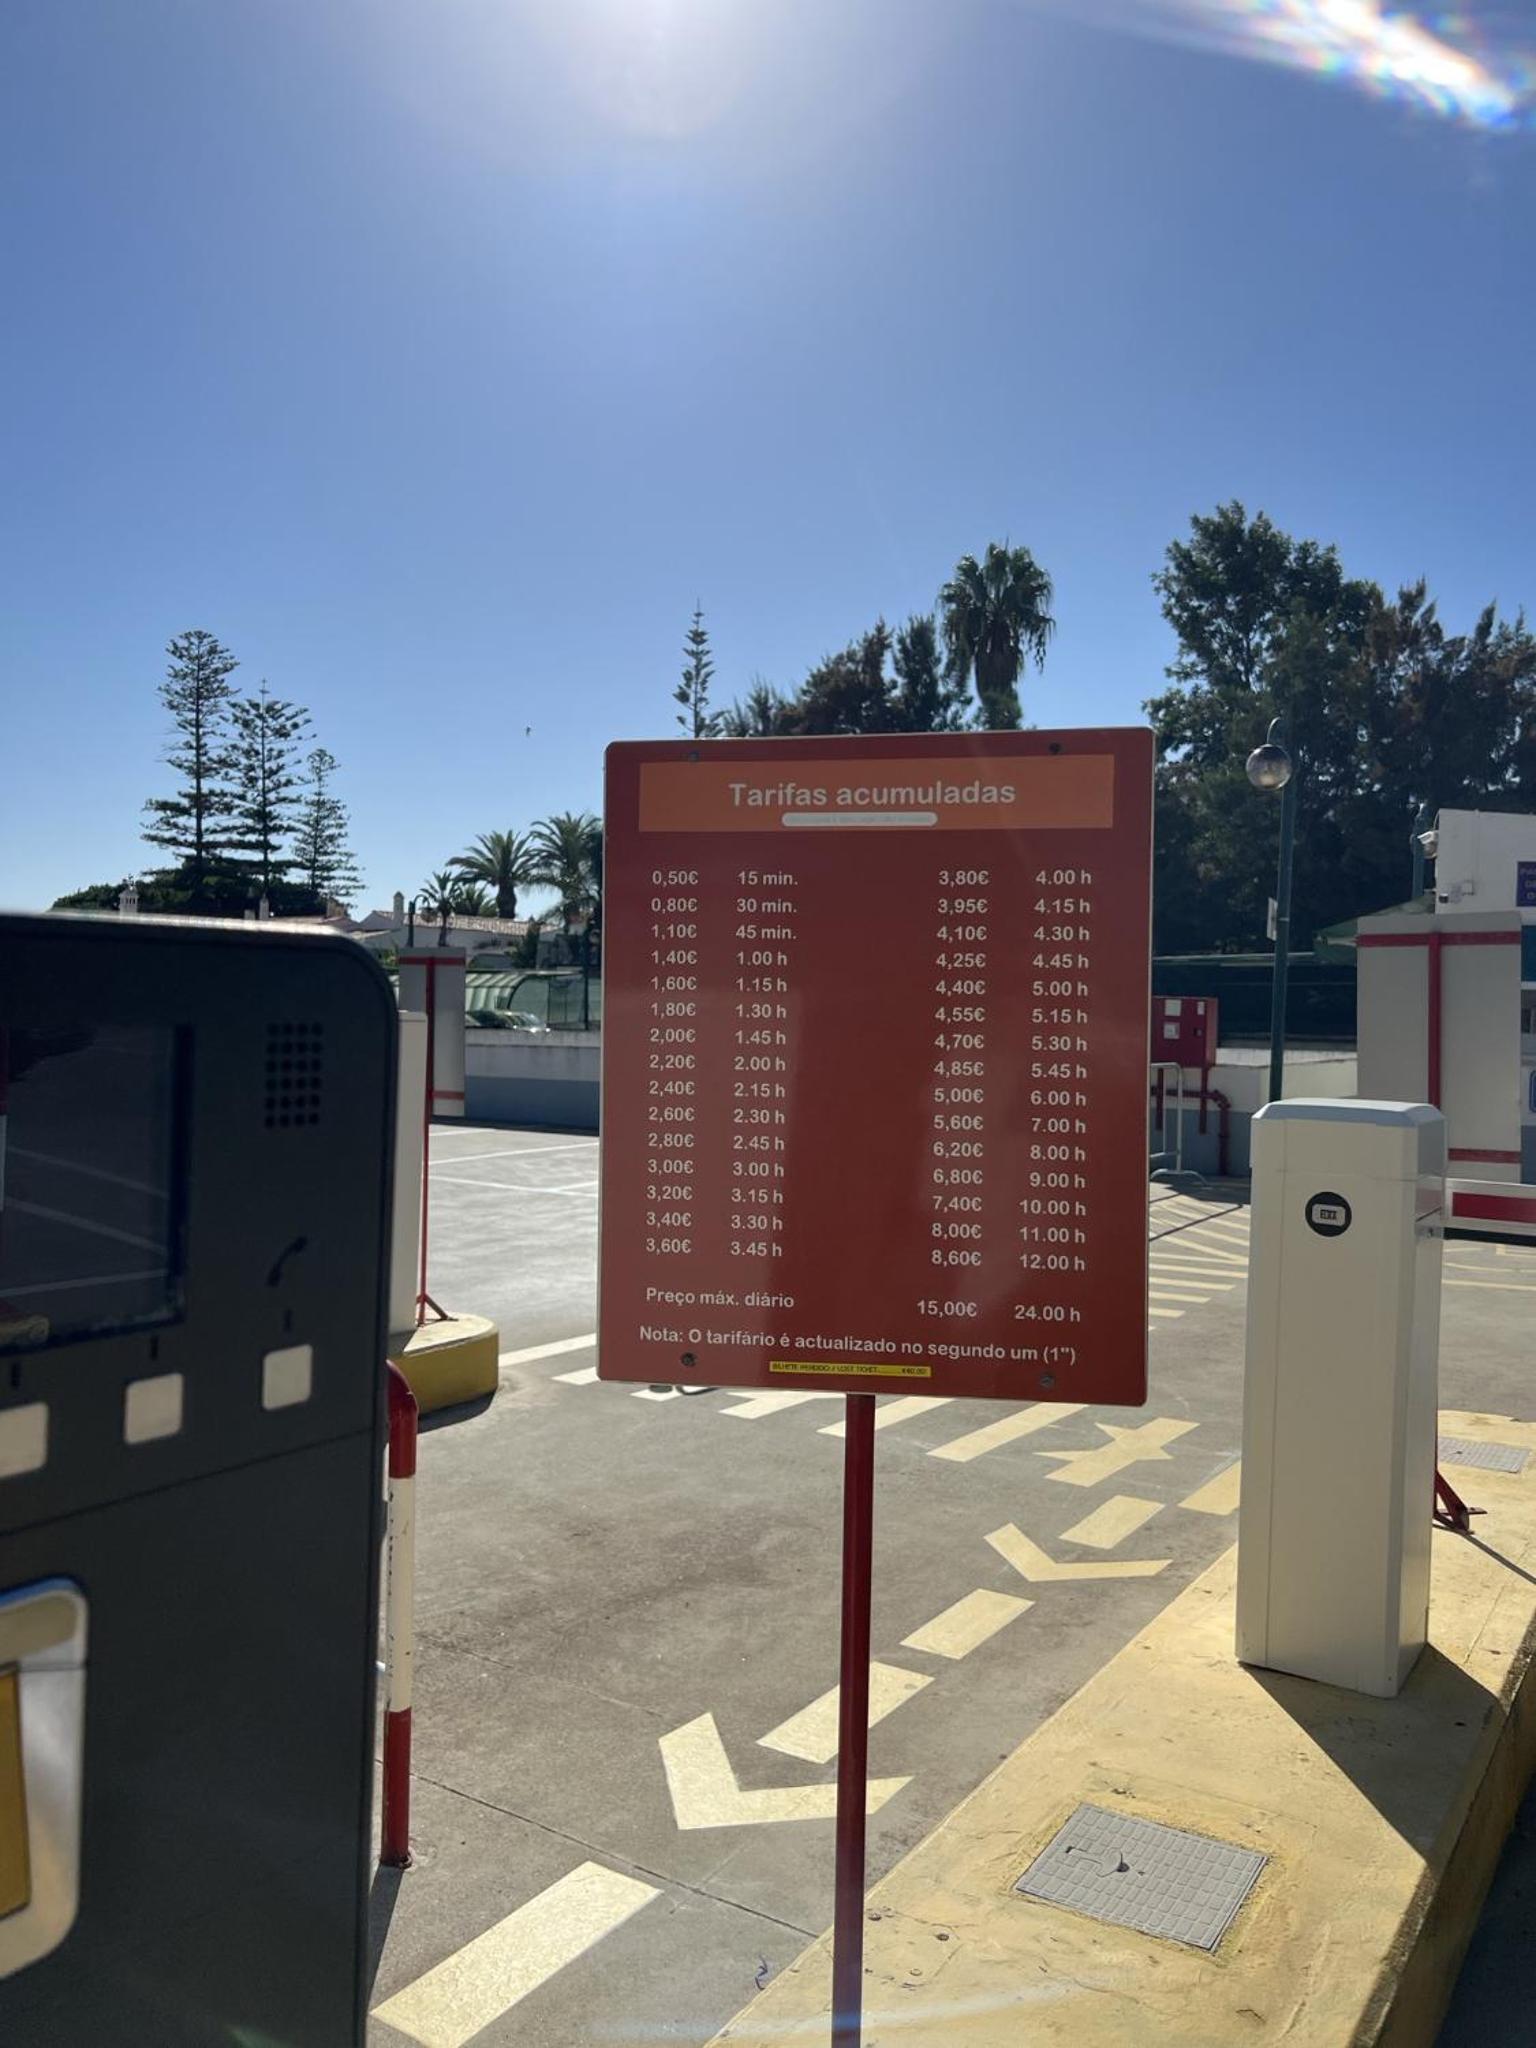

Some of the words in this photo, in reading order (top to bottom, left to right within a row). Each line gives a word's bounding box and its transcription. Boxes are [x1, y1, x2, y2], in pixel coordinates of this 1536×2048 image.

[730, 783, 826, 806] Tarifas
[836, 781, 1015, 804] acumuladas
[652, 870, 698, 887] 0,50€
[738, 871, 758, 885] 15
[763, 871, 798, 885] min.
[939, 870, 989, 887] 3,80€
[1036, 870, 1075, 884] 4.00
[1081, 870, 1091, 884] h
[652, 898, 697, 914] 0,80€
[737, 898, 757, 912] 30
[762, 899, 796, 912] min.
[938, 899, 988, 915] 3,95€
[1034, 898, 1074, 913] 4.15
[1080, 898, 1090, 913] h
[652, 924, 696, 940] 1,10€
[736, 925, 757, 939] 45
[762, 925, 796, 939] min.
[937, 926, 987, 943] 4,10€
[1034, 926, 1073, 940] 4.30
[1079, 926, 1090, 940] h
[652, 950, 697, 966] 1,40€
[737, 951, 772, 965] 1.00
[778, 952, 787, 965] h
[936, 953, 986, 970] 4,25€
[1033, 954, 1072, 968] 4.45
[1078, 954, 1089, 968] h
[652, 977, 696, 992] 1,60€
[736, 978, 772, 992] 1.15
[777, 978, 787, 992] h
[936, 980, 986, 996] 4,40€
[1033, 981, 1072, 996] 5.00
[1078, 982, 1088, 996] h
[652, 1003, 696, 1018] 1,80€
[736, 1004, 771, 1018] 1.30
[777, 1004, 786, 1018] h
[935, 1007, 985, 1024] 4,55€
[1032, 1008, 1071, 1023] 5.15
[1077, 1009, 1087, 1023] h
[650, 1028, 696, 1044] 2,00€
[736, 1030, 771, 1044] 1.45
[776, 1030, 786, 1044] h
[934, 1034, 984, 1051] 4,70€
[1032, 1036, 1071, 1050] 5.30
[1077, 1036, 1087, 1051] h
[650, 1055, 695, 1071] 2,20€
[734, 1056, 770, 1071] 2.00
[776, 1056, 785, 1071] h
[934, 1061, 984, 1078] 4,85€
[1032, 1063, 1070, 1078] 5.45
[1076, 1064, 1087, 1078] h
[650, 1081, 694, 1097] 2,40€
[734, 1082, 770, 1097] 2.15
[775, 1084, 785, 1098] h
[935, 1088, 983, 1104] 5,00€
[1031, 1090, 1070, 1105] 6.00
[1076, 1092, 1086, 1106] h
[649, 1107, 694, 1122] 2,60€
[734, 1108, 770, 1123] 2.30
[775, 1110, 785, 1124] h
[934, 1115, 983, 1131] 5,60€
[1032, 1118, 1070, 1132] 7.00
[1075, 1119, 1086, 1133] h
[649, 1133, 694, 1149] 2,80€
[734, 1136, 769, 1150] 2.45
[775, 1136, 784, 1150] h
[934, 1142, 983, 1158] 6,20€
[1031, 1145, 1069, 1160] 8.00
[1075, 1146, 1086, 1161] h
[648, 1159, 693, 1175] 3,00€
[733, 1162, 769, 1176] 3.00
[775, 1163, 784, 1177] h
[934, 1168, 983, 1186] 6,80€
[1030, 1172, 1069, 1188] 9.00
[1075, 1174, 1085, 1188] h
[647, 1185, 692, 1202] 3,20€
[732, 1188, 768, 1203] 3.15
[773, 1190, 783, 1203] h
[933, 1196, 982, 1212] 7,40€
[1020, 1200, 1070, 1215] 10.00
[1076, 1201, 1086, 1216] h
[646, 1212, 691, 1228] 3,40€
[732, 1215, 768, 1230] 3.30
[773, 1216, 783, 1230] h
[932, 1223, 982, 1240] 8,00€
[1020, 1227, 1069, 1242] 11.00
[1075, 1228, 1085, 1243] h
[646, 1238, 691, 1255] 3,60€
[731, 1242, 767, 1256] 3.45
[772, 1243, 782, 1256] h
[932, 1250, 981, 1267] 8,60€
[1020, 1254, 1069, 1270] 12.00
[1074, 1256, 1085, 1271] h
[647, 1288, 695, 1306] Preço
[700, 1290, 739, 1306] máx.
[745, 1292, 794, 1308] diário
[917, 1300, 977, 1318] 15,00€
[1015, 1305, 1065, 1321] 24.00
[1070, 1307, 1080, 1322] h
[640, 1326, 683, 1342] Nota:
[689, 1329, 701, 1343] O
[707, 1330, 776, 1346] tarifário
[780, 1333, 790, 1347] é
[795, 1335, 896, 1352] actualizado
[902, 1343, 923, 1354] no
[928, 1344, 1005, 1360] segundo
[1011, 1349, 1038, 1360] um
[1043, 1348, 1076, 1365] (1")
